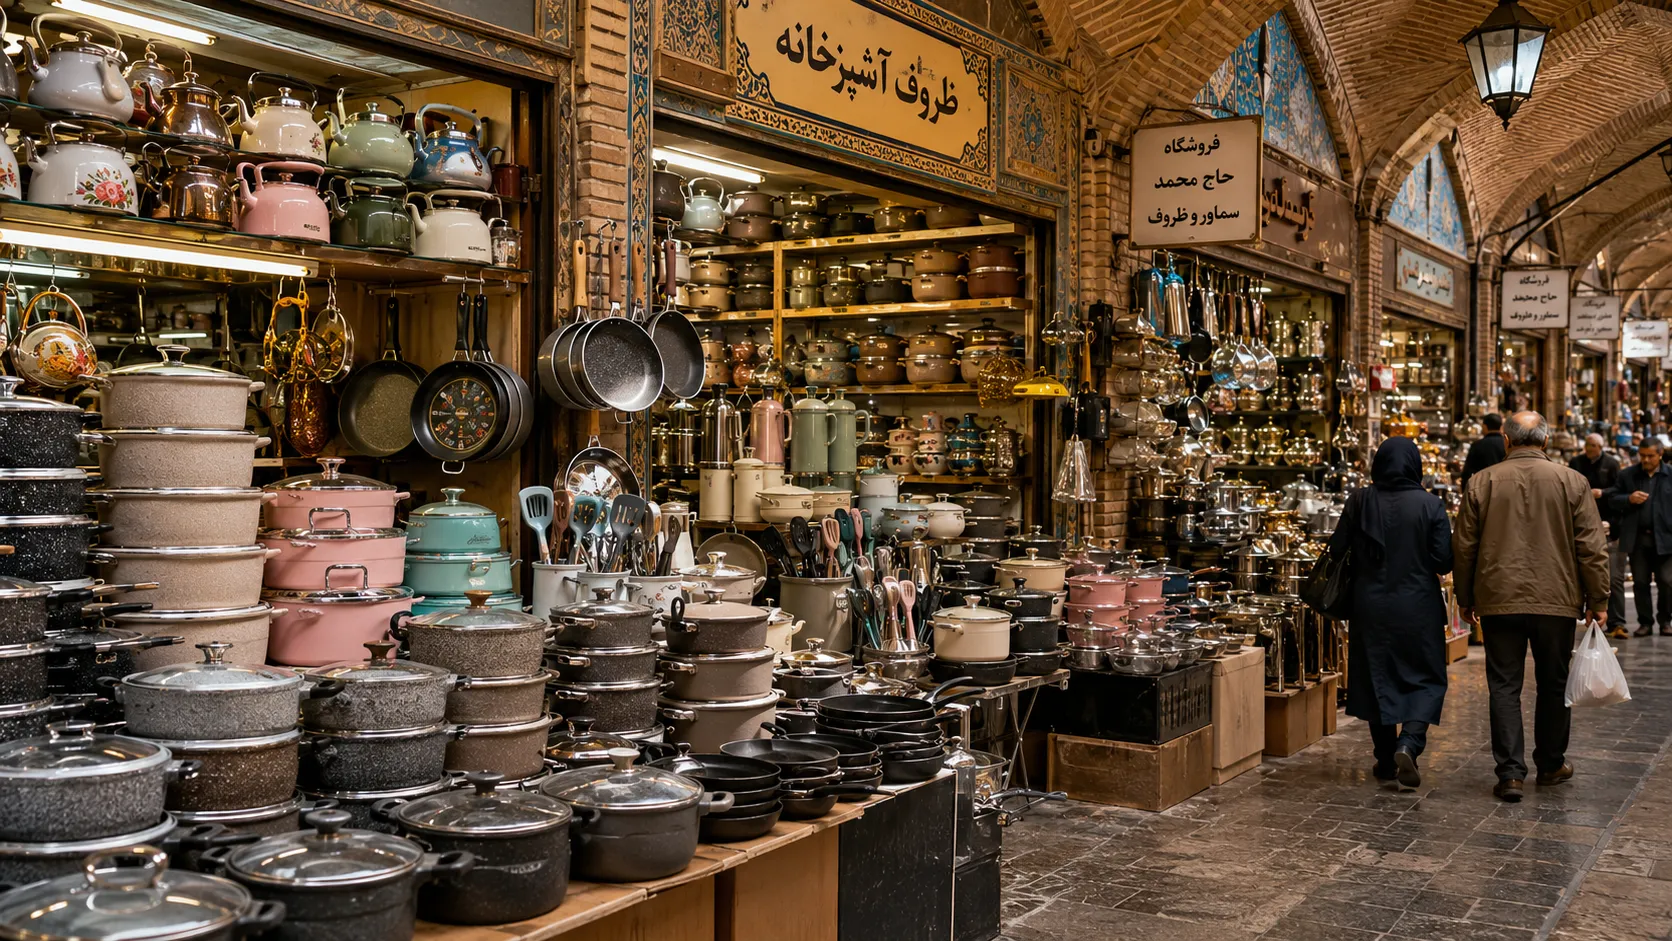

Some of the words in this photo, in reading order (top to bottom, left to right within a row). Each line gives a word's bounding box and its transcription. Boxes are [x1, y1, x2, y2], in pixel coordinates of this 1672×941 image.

[776, 22, 892, 101] آشپزخانه
[895, 63, 959, 124] ظروف
[1164, 134, 1220, 155] فروشگاه
[1154, 175, 1198, 189] محمد
[1202, 168, 1234, 190] حاج
[1148, 207, 1188, 228] ظروف
[1190, 214, 1198, 226] و
[1199, 205, 1240, 225] سماور
